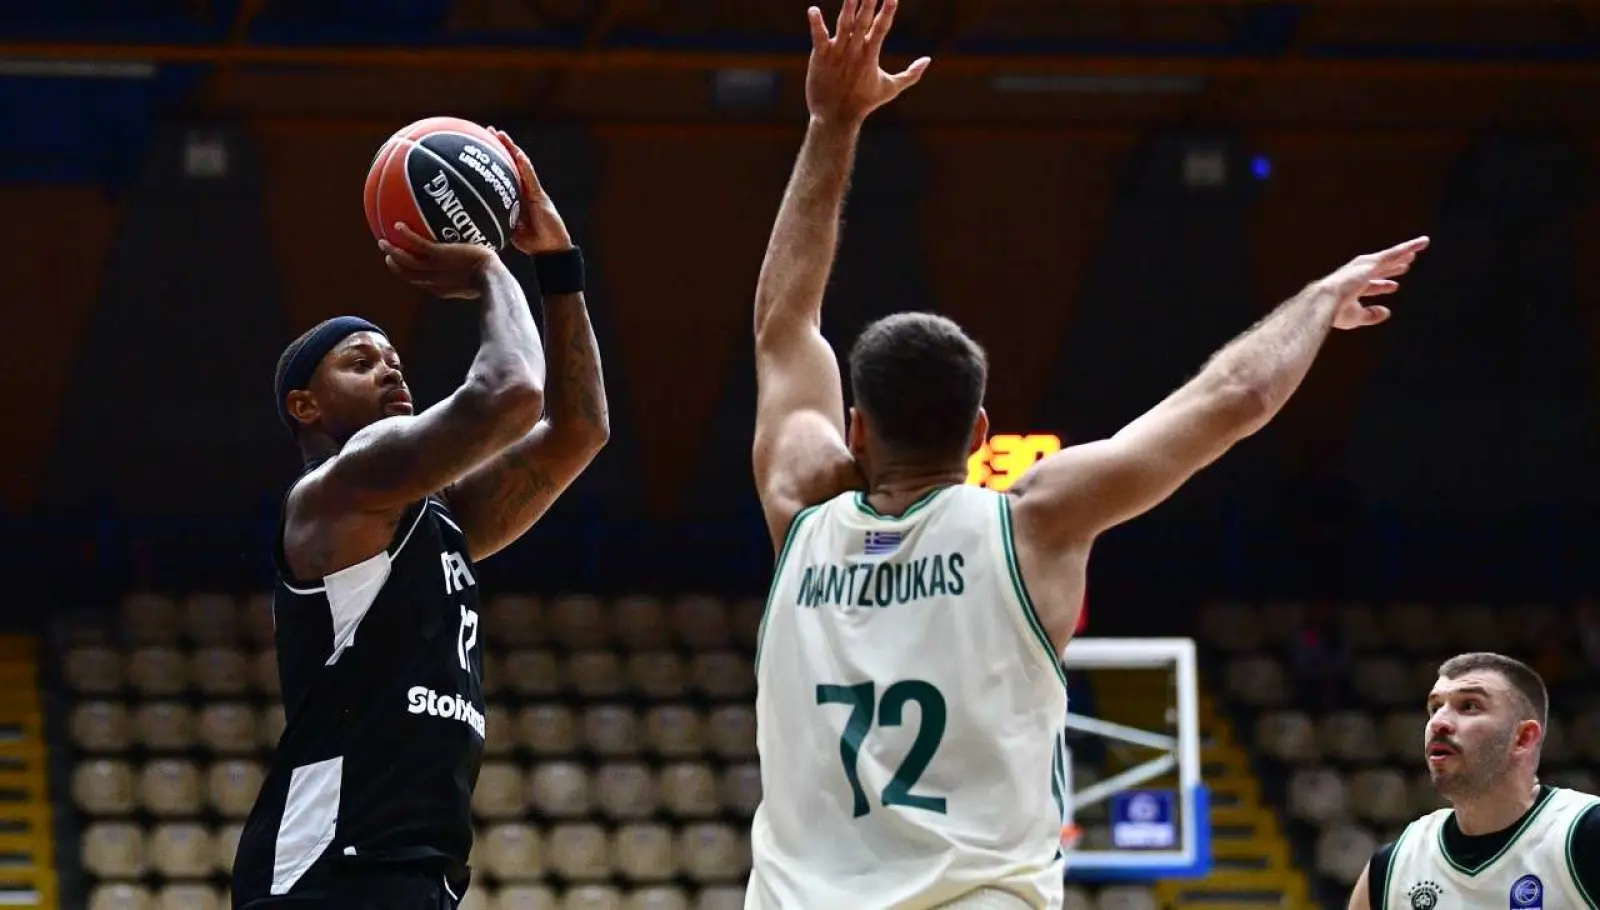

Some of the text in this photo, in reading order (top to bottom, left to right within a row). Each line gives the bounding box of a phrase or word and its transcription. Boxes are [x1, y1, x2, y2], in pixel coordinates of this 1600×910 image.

[464, 145, 490, 164] CUP
[424, 170, 496, 250] ALDING
[796, 552, 965, 608] MANTZOUKAS
[816, 679, 947, 818] 72
